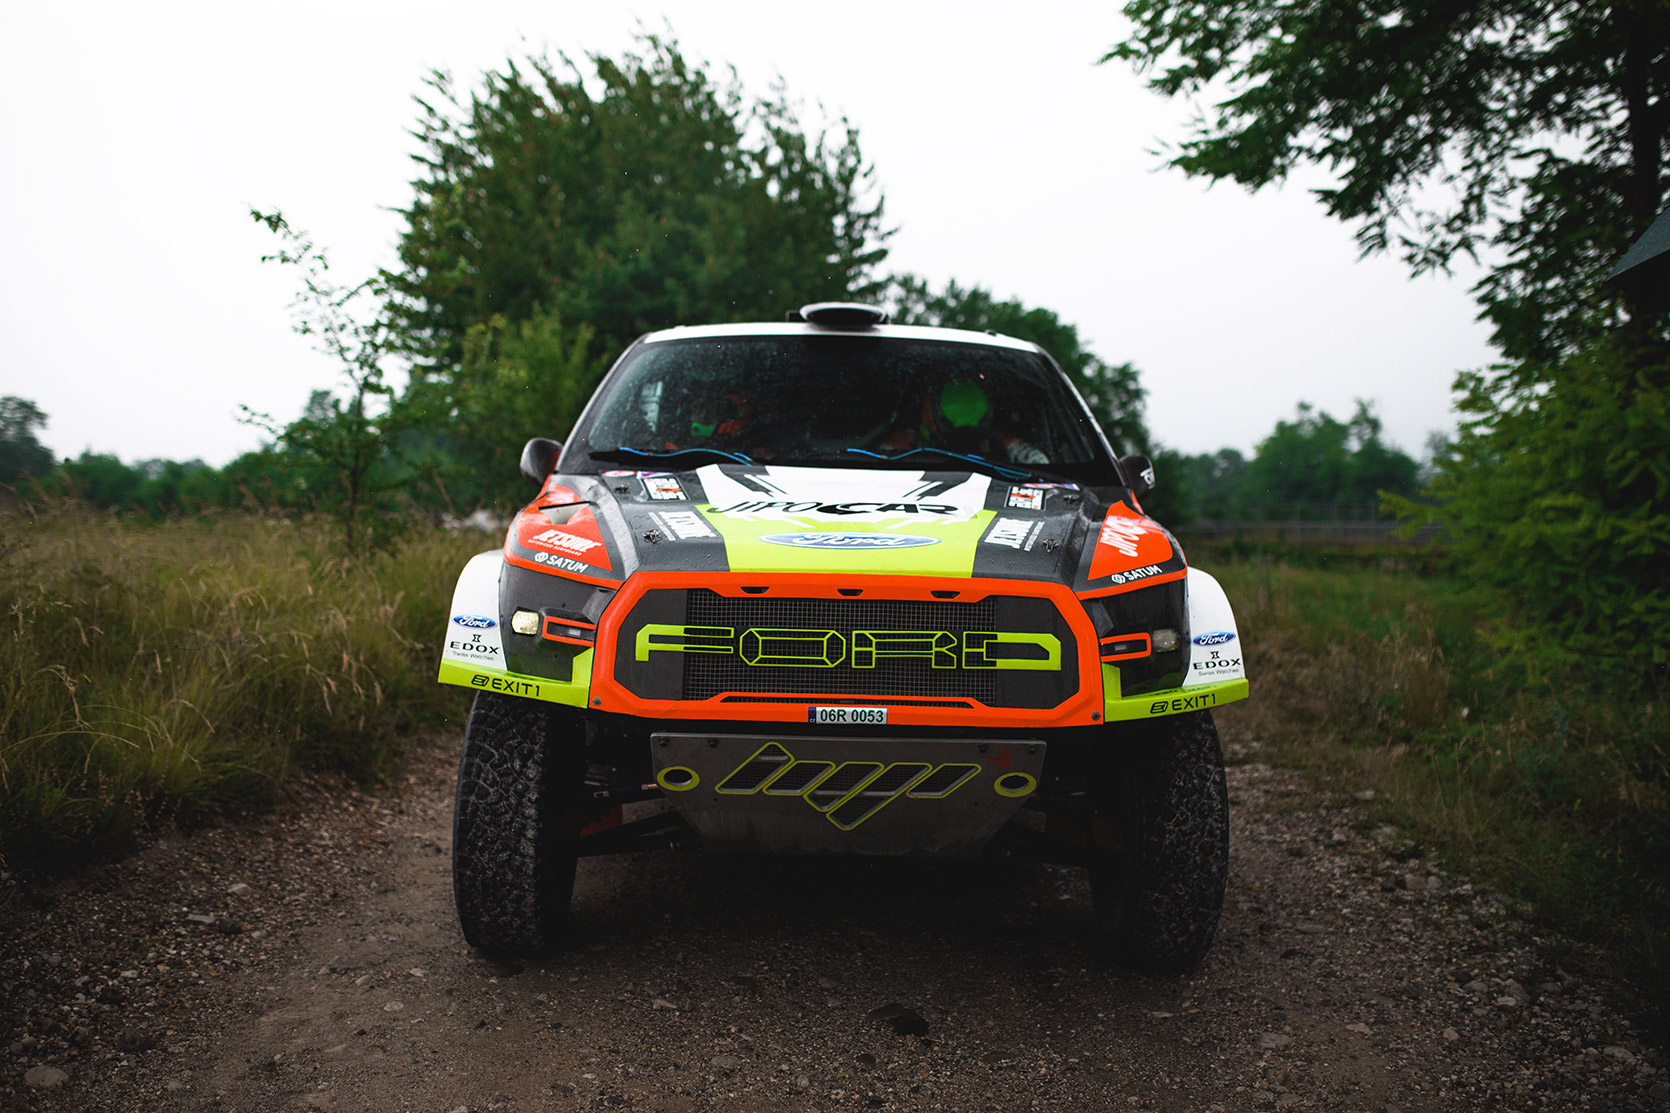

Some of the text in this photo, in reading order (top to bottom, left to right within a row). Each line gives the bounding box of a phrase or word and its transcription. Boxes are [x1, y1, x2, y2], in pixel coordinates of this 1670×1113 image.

[707, 501, 958, 515] JIPOCAR
[533, 529, 602, 552] JETSURF
[546, 555, 589, 573] SATUM
[1124, 565, 1163, 581] SATUM
[450, 641, 500, 655] EDOX
[635, 624, 1062, 671] FORD
[1193, 658, 1241, 670] EDOX
[491, 678, 541, 697] EXIT1
[1172, 693, 1216, 711] EXIT1
[820, 709, 884, 722] 06R 0053
